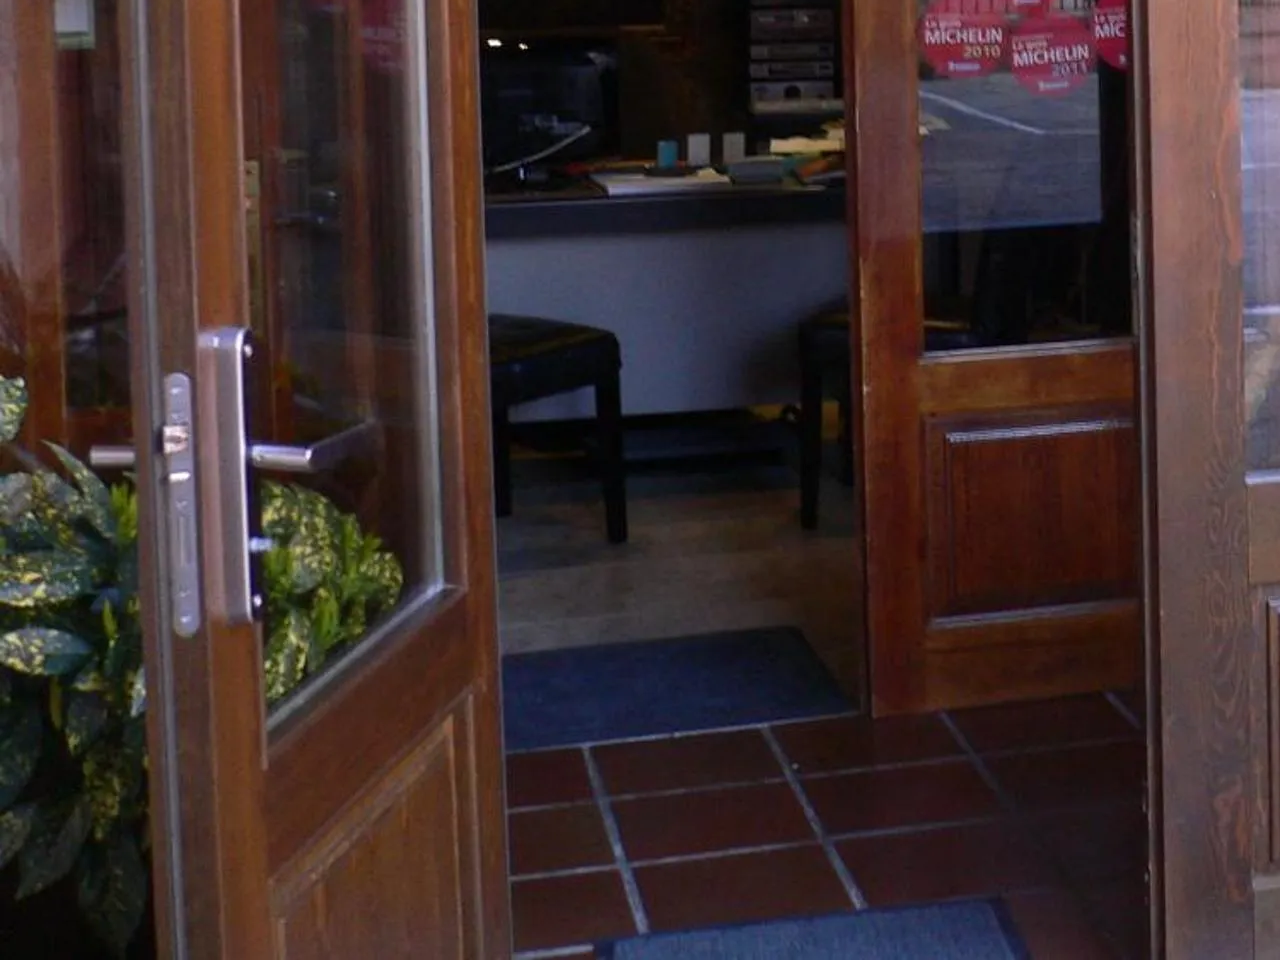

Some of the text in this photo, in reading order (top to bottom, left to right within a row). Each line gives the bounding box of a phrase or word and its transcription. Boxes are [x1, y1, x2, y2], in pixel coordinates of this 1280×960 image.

[925, 27, 1002, 44] MICHELIN
[1096, 23, 1125, 38] MIC
[964, 44, 1000, 58] 2010
[1013, 44, 1089, 67] MICHELIN
